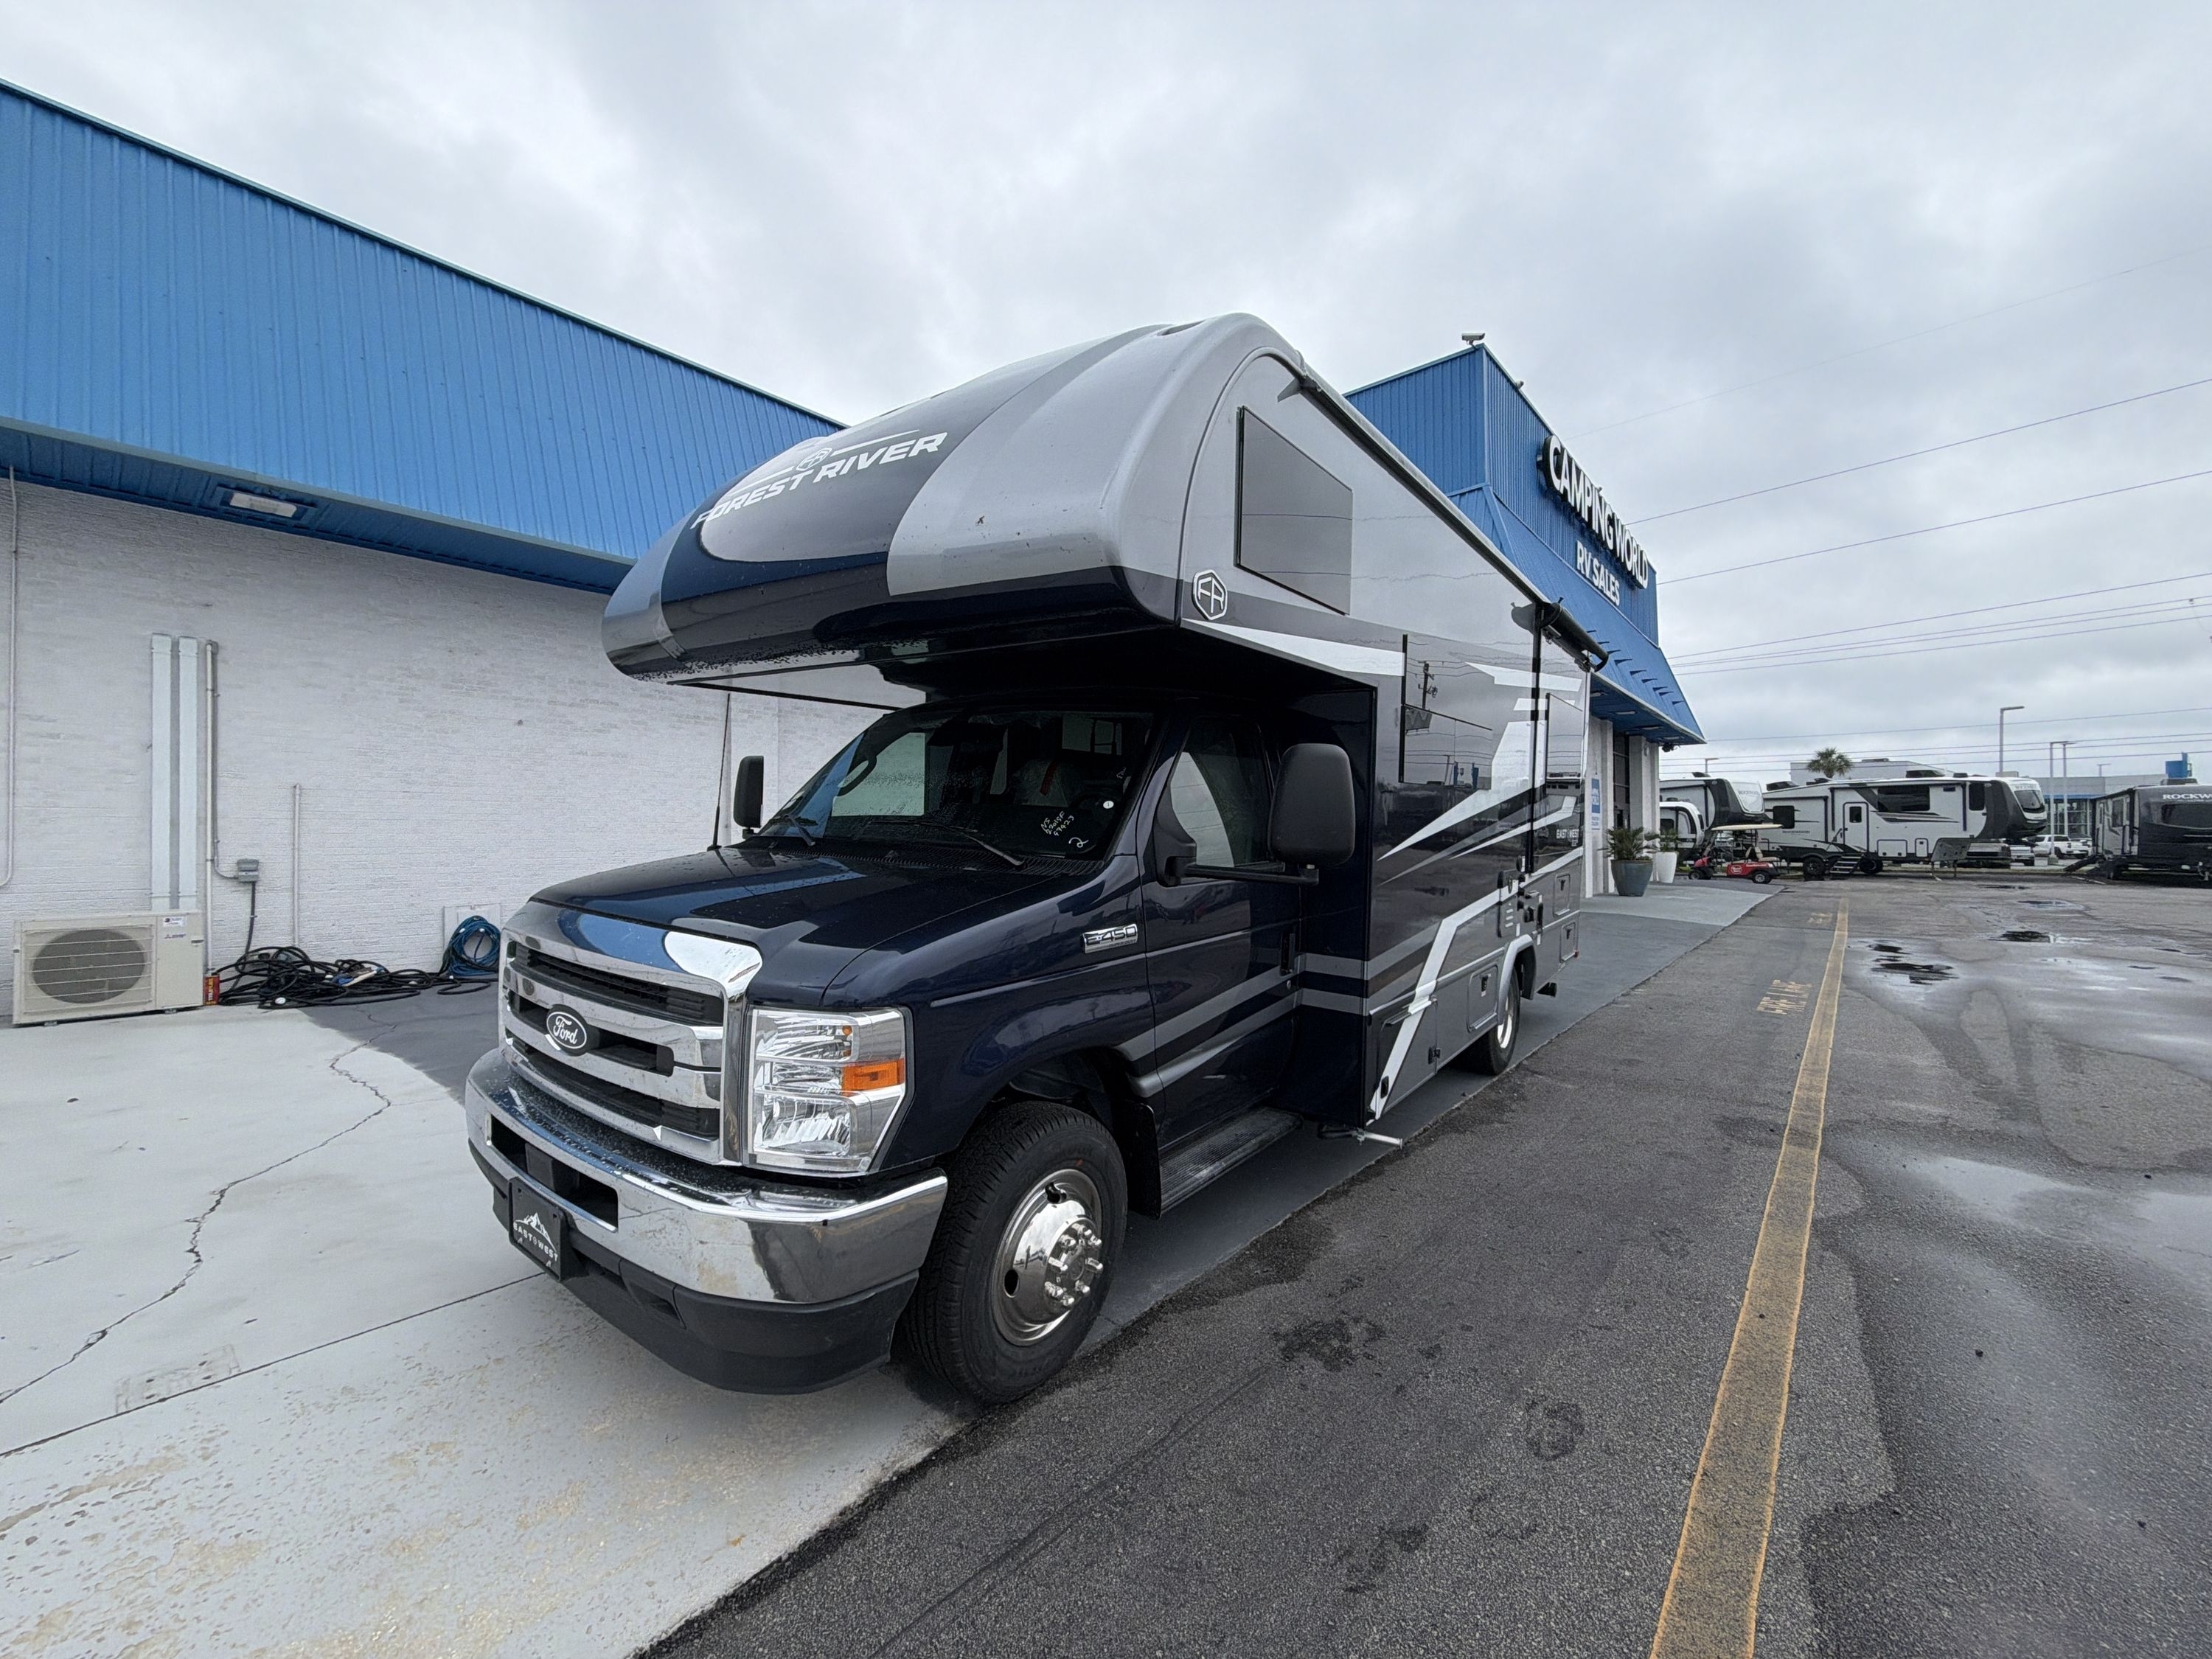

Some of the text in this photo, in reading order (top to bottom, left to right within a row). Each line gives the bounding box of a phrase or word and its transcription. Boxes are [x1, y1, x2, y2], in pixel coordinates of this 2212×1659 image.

[690, 432, 948, 529] FOREST RIVER
[1544, 434, 1649, 589] CAMPING WORLD
[1576, 540, 1621, 606] RV SALES
[1084, 926, 1137, 946] E-450
[553, 1015, 578, 1044] Ford
[513, 1221, 532, 1241] EAST
[538, 1239, 558, 1262] WEST
